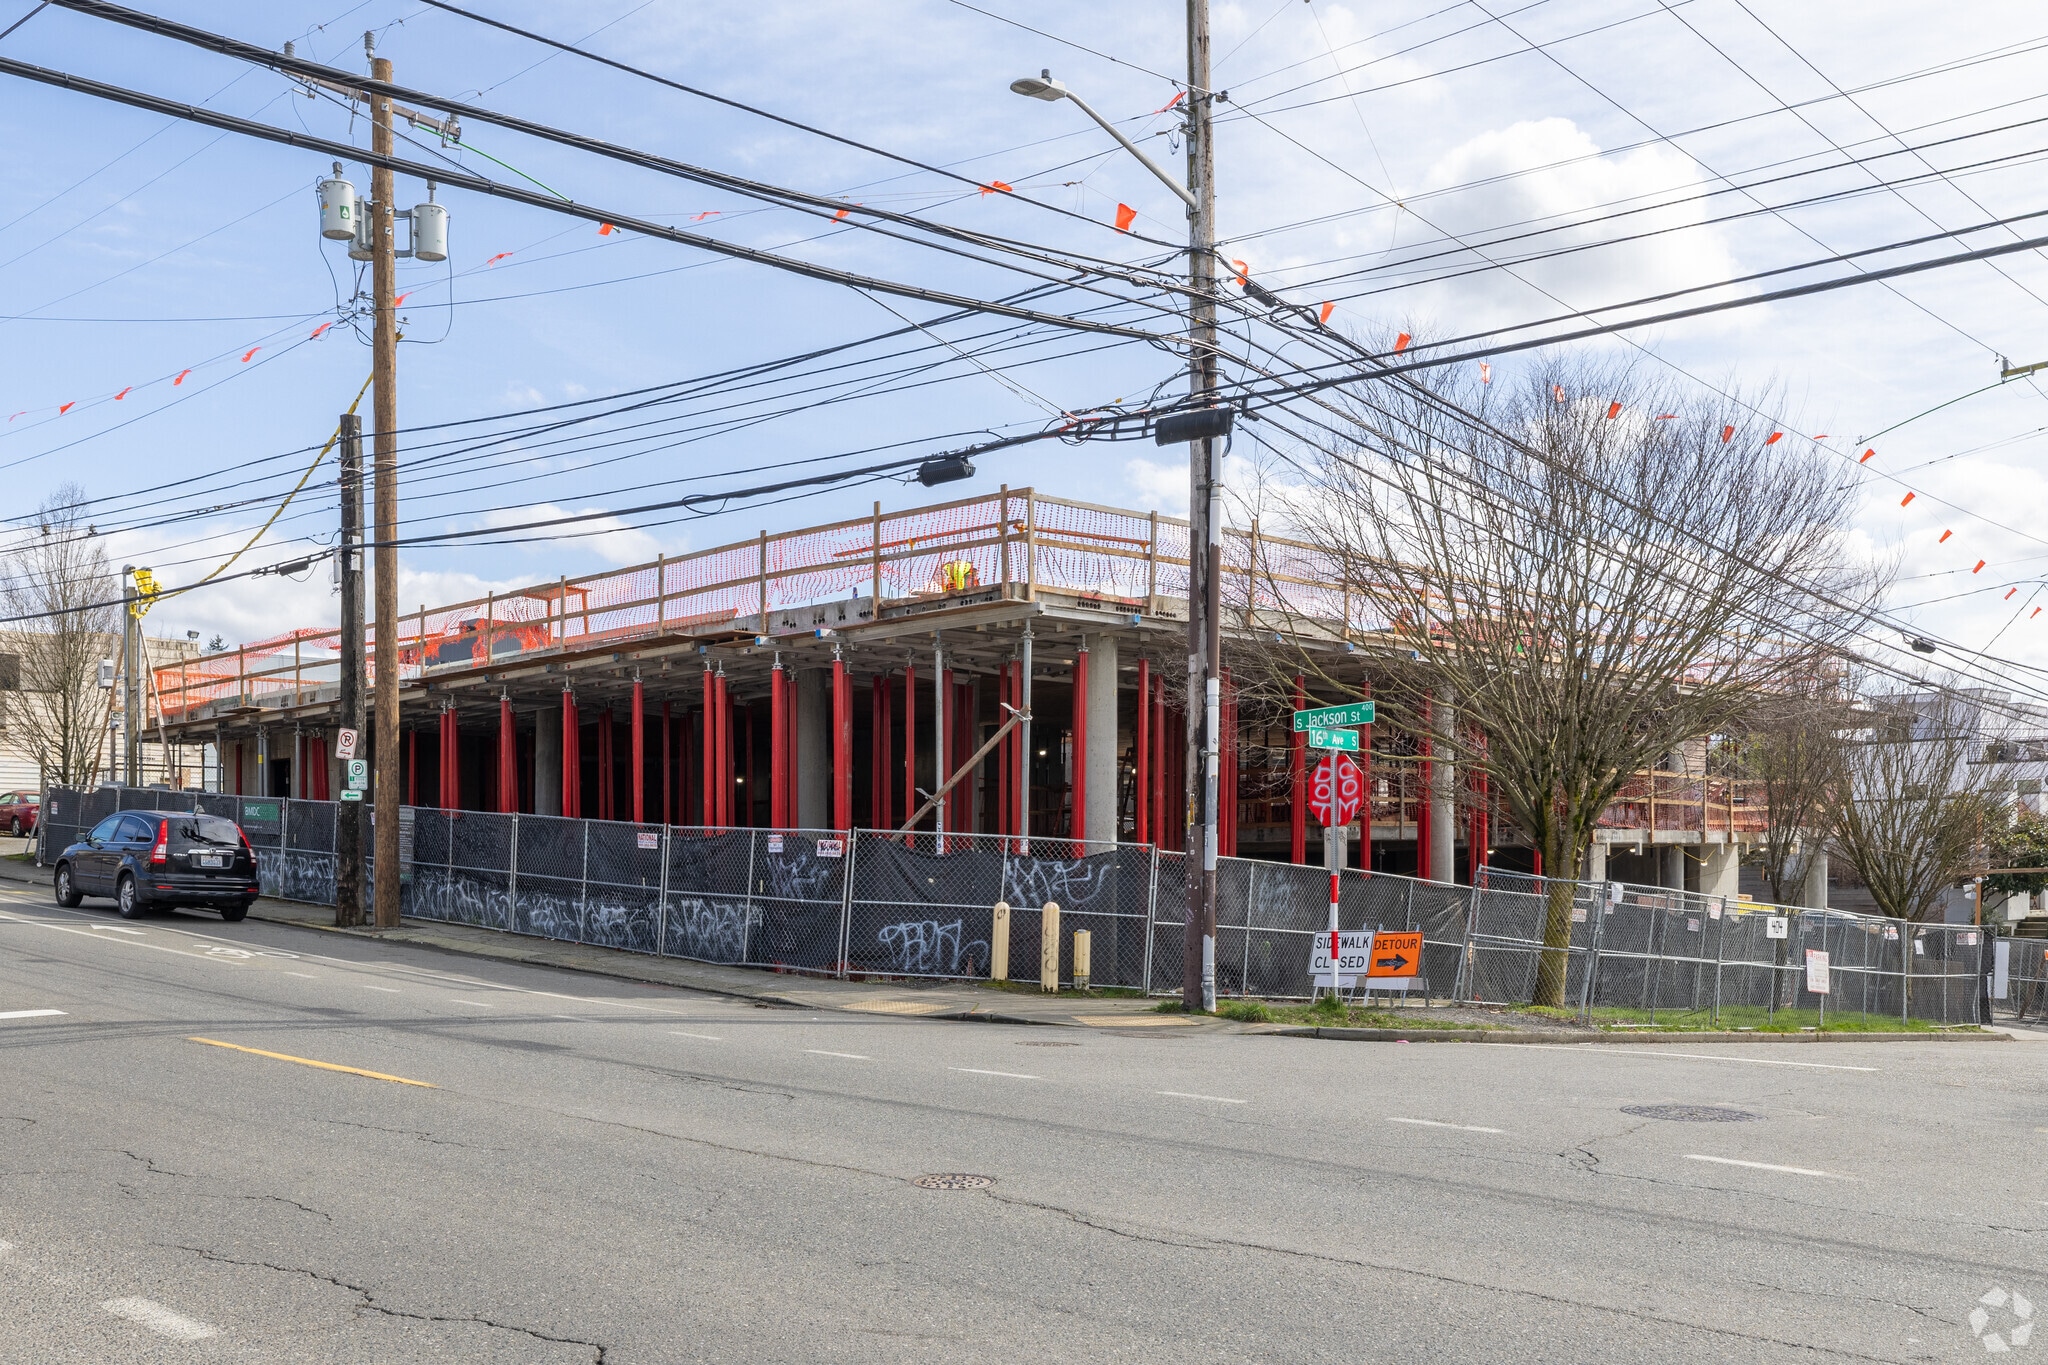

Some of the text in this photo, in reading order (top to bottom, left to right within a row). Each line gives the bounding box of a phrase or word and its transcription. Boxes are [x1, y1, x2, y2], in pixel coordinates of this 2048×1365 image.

[1361, 703, 1373, 711] 400
[1296, 711, 1360, 729] S Jackson St
[1311, 729, 1357, 747] 16th Ave S
[1771, 920, 1783, 934] 404
[1375, 938, 1418, 950] DETOUR
[1315, 956, 1365, 969] CLSED
